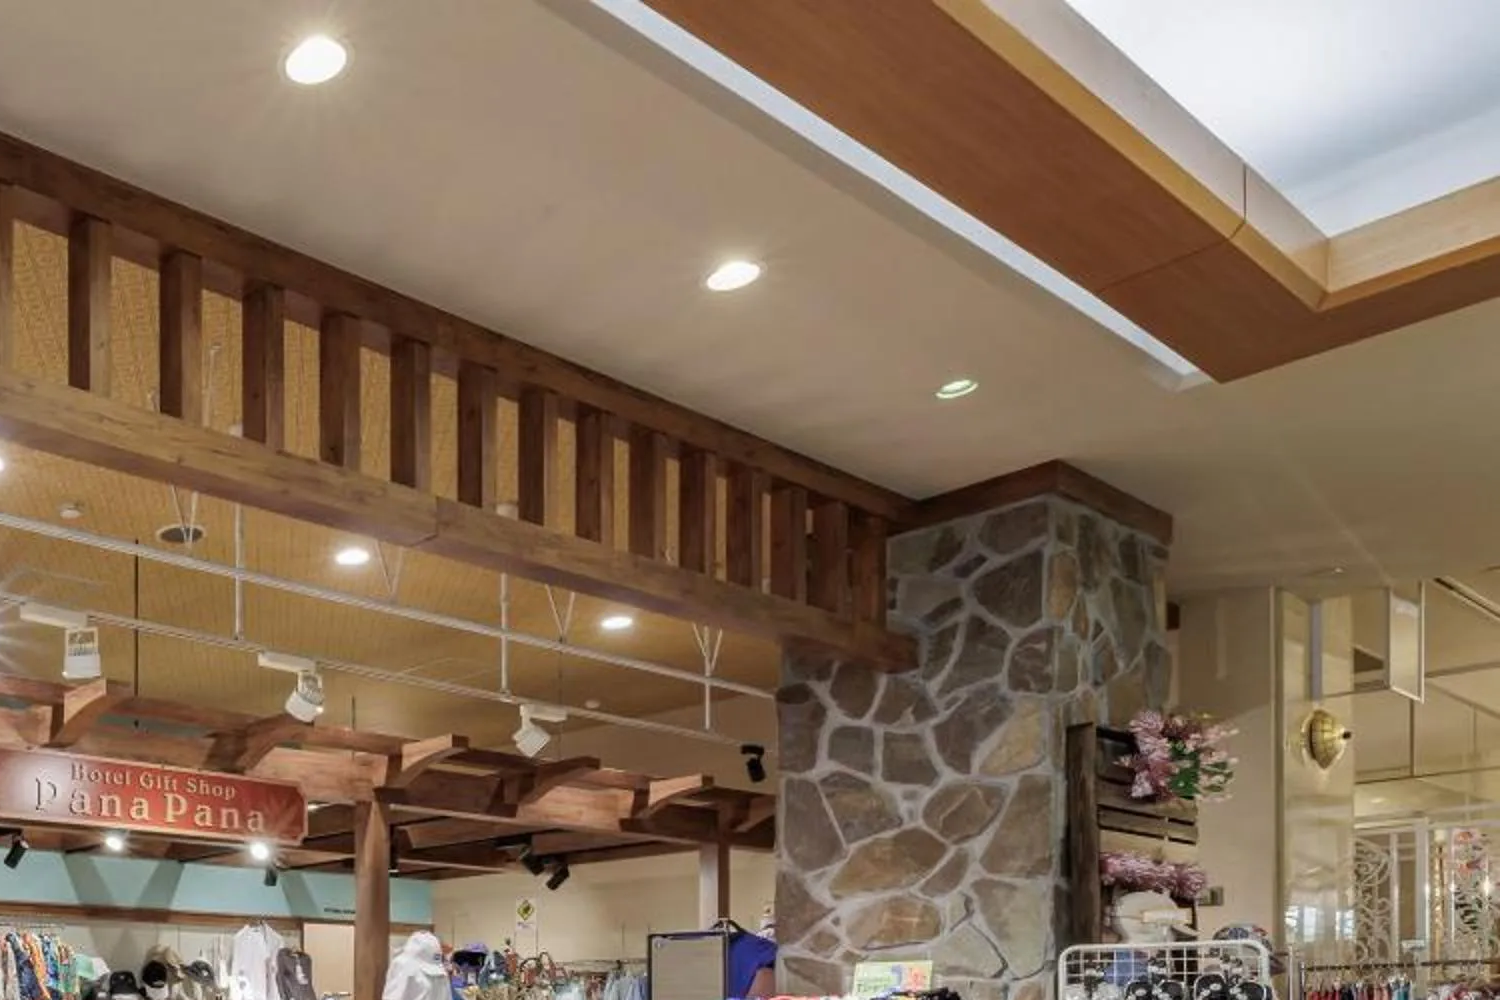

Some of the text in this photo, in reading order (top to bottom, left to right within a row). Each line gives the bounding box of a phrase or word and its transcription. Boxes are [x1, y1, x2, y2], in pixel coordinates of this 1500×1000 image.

[71, 762, 236, 800] Hotel Gift Shop
